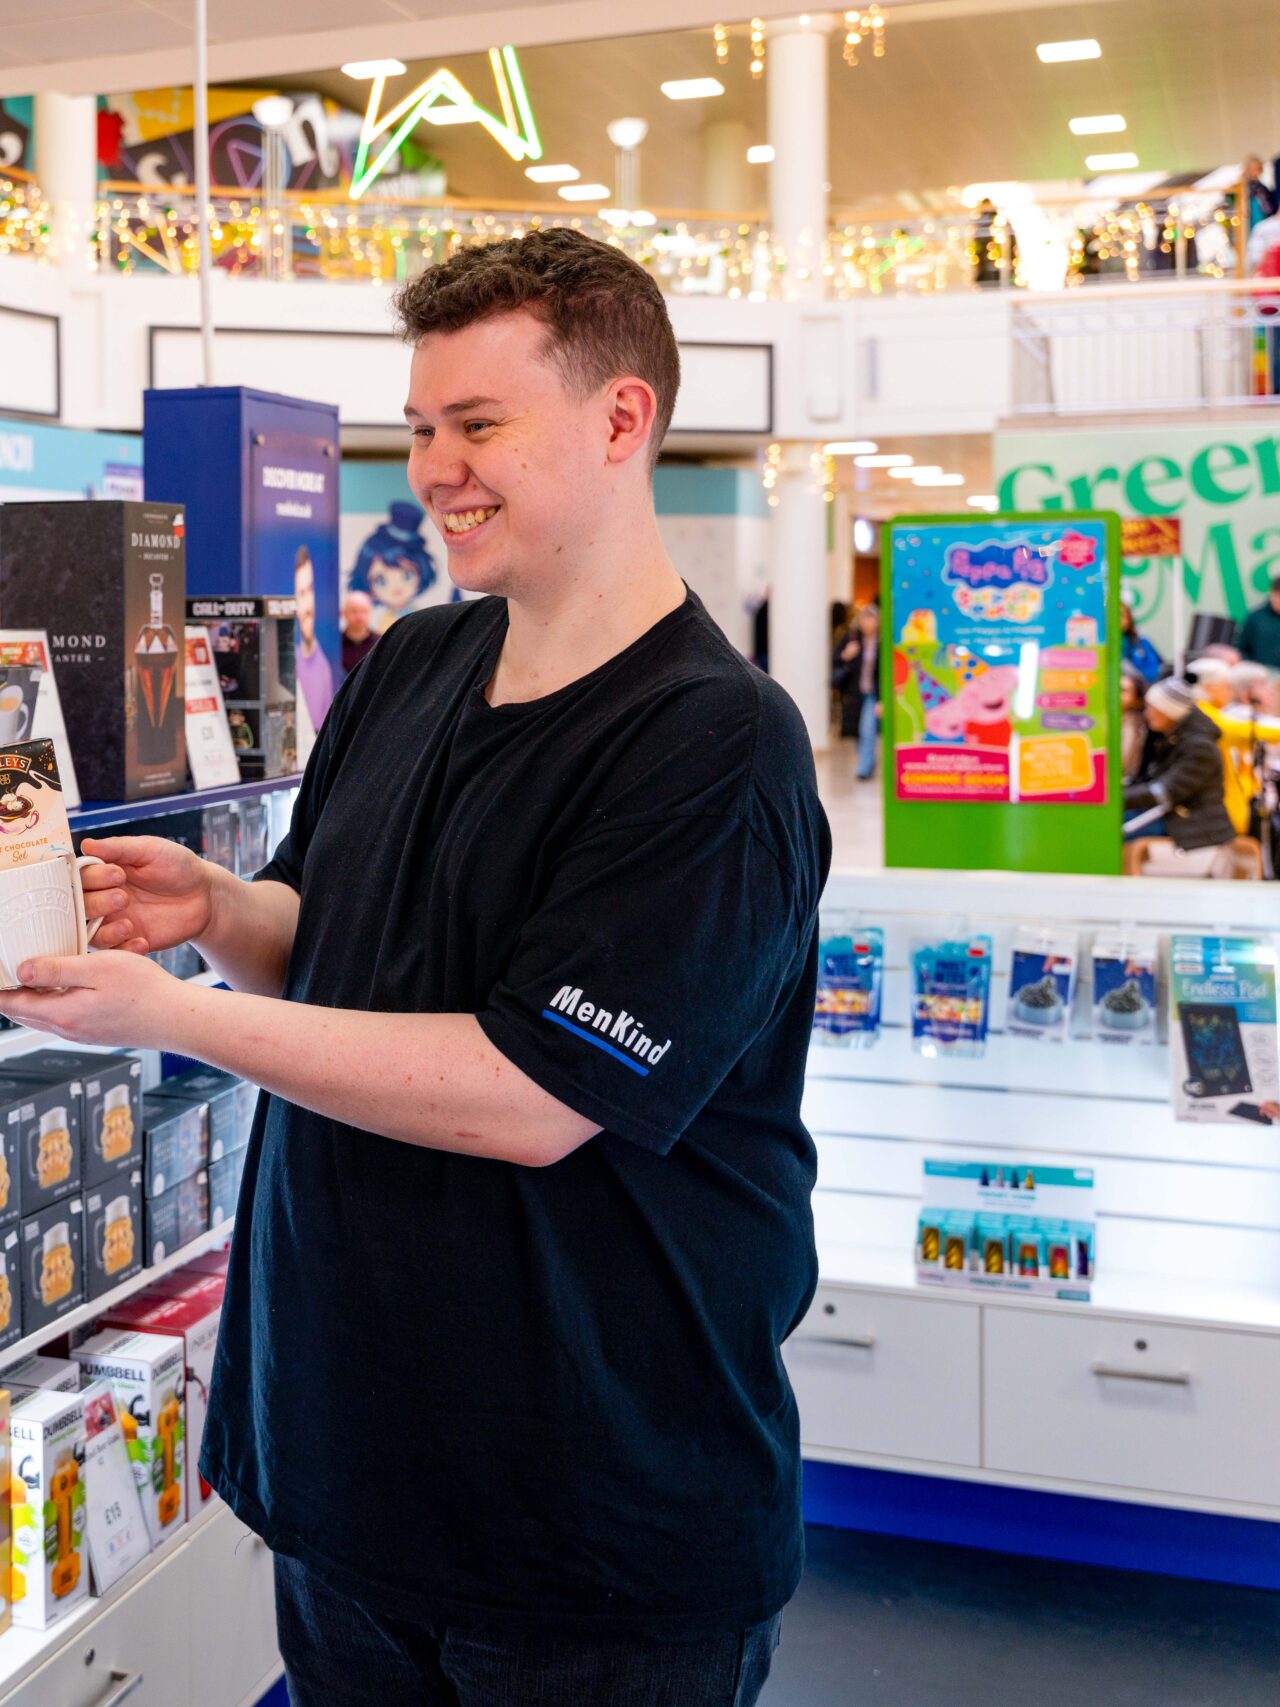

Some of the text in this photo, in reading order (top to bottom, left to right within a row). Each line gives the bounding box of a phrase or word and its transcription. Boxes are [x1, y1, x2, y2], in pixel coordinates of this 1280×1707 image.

[131, 532, 181, 549] DIAMOND
[51, 634, 107, 649] MOND
[4, 837, 49, 852] CHOCOLATE
[12, 849, 28, 863] Set
[549, 985, 672, 1066] MenKind
[79, 1362, 146, 1382] DUMBBELL
[43, 1406, 83, 1441] DUMBBELL
[10, 1426, 35, 1441] ELL
[104, 1501, 122, 1526] £15
